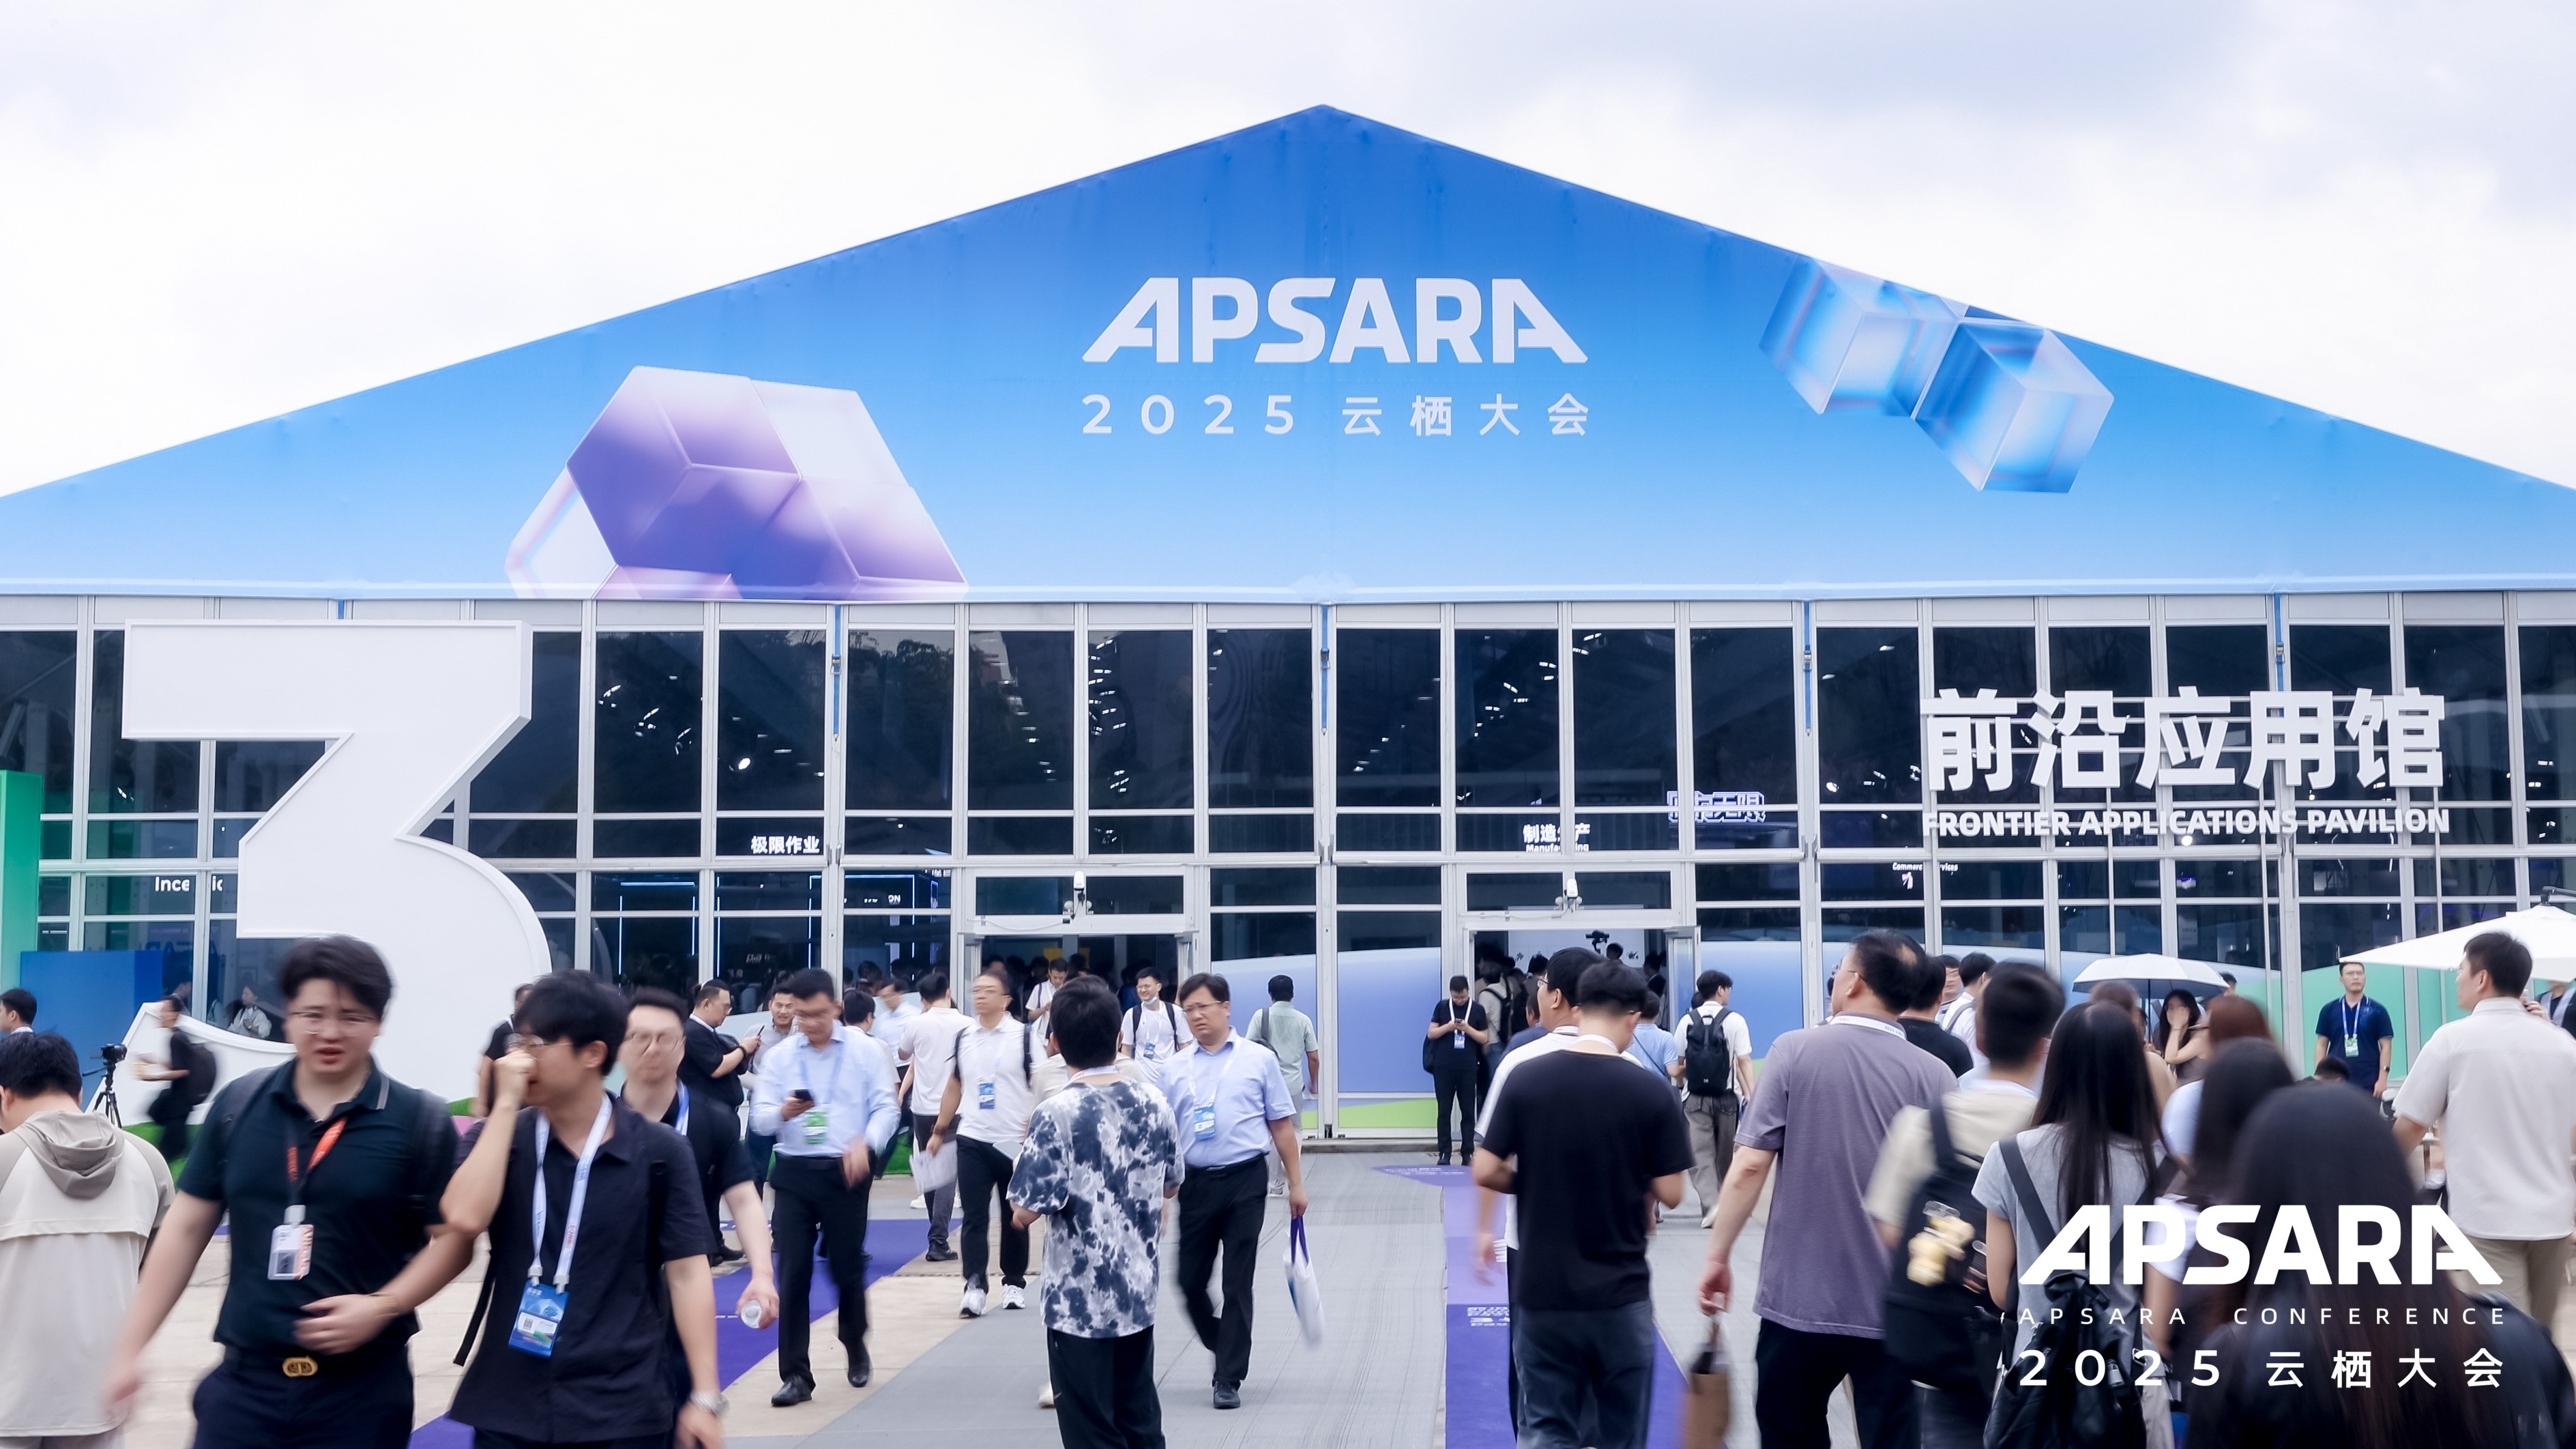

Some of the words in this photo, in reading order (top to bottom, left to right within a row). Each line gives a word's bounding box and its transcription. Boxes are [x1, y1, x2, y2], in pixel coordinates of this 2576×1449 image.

[1082, 277, 1589, 363] APSARA
[1082, 394, 1294, 435] 2025
[1342, 393, 1588, 436] 云栖大会
[1920, 686, 2445, 791] 前沿应用馆
[1523, 823, 1590, 843] 制造产
[1923, 811, 2071, 836] FRONTIER
[2078, 810, 2298, 836] APPLICATIONS
[2307, 808, 2450, 834] PAVILION
[750, 835, 820, 854] 极限作业
